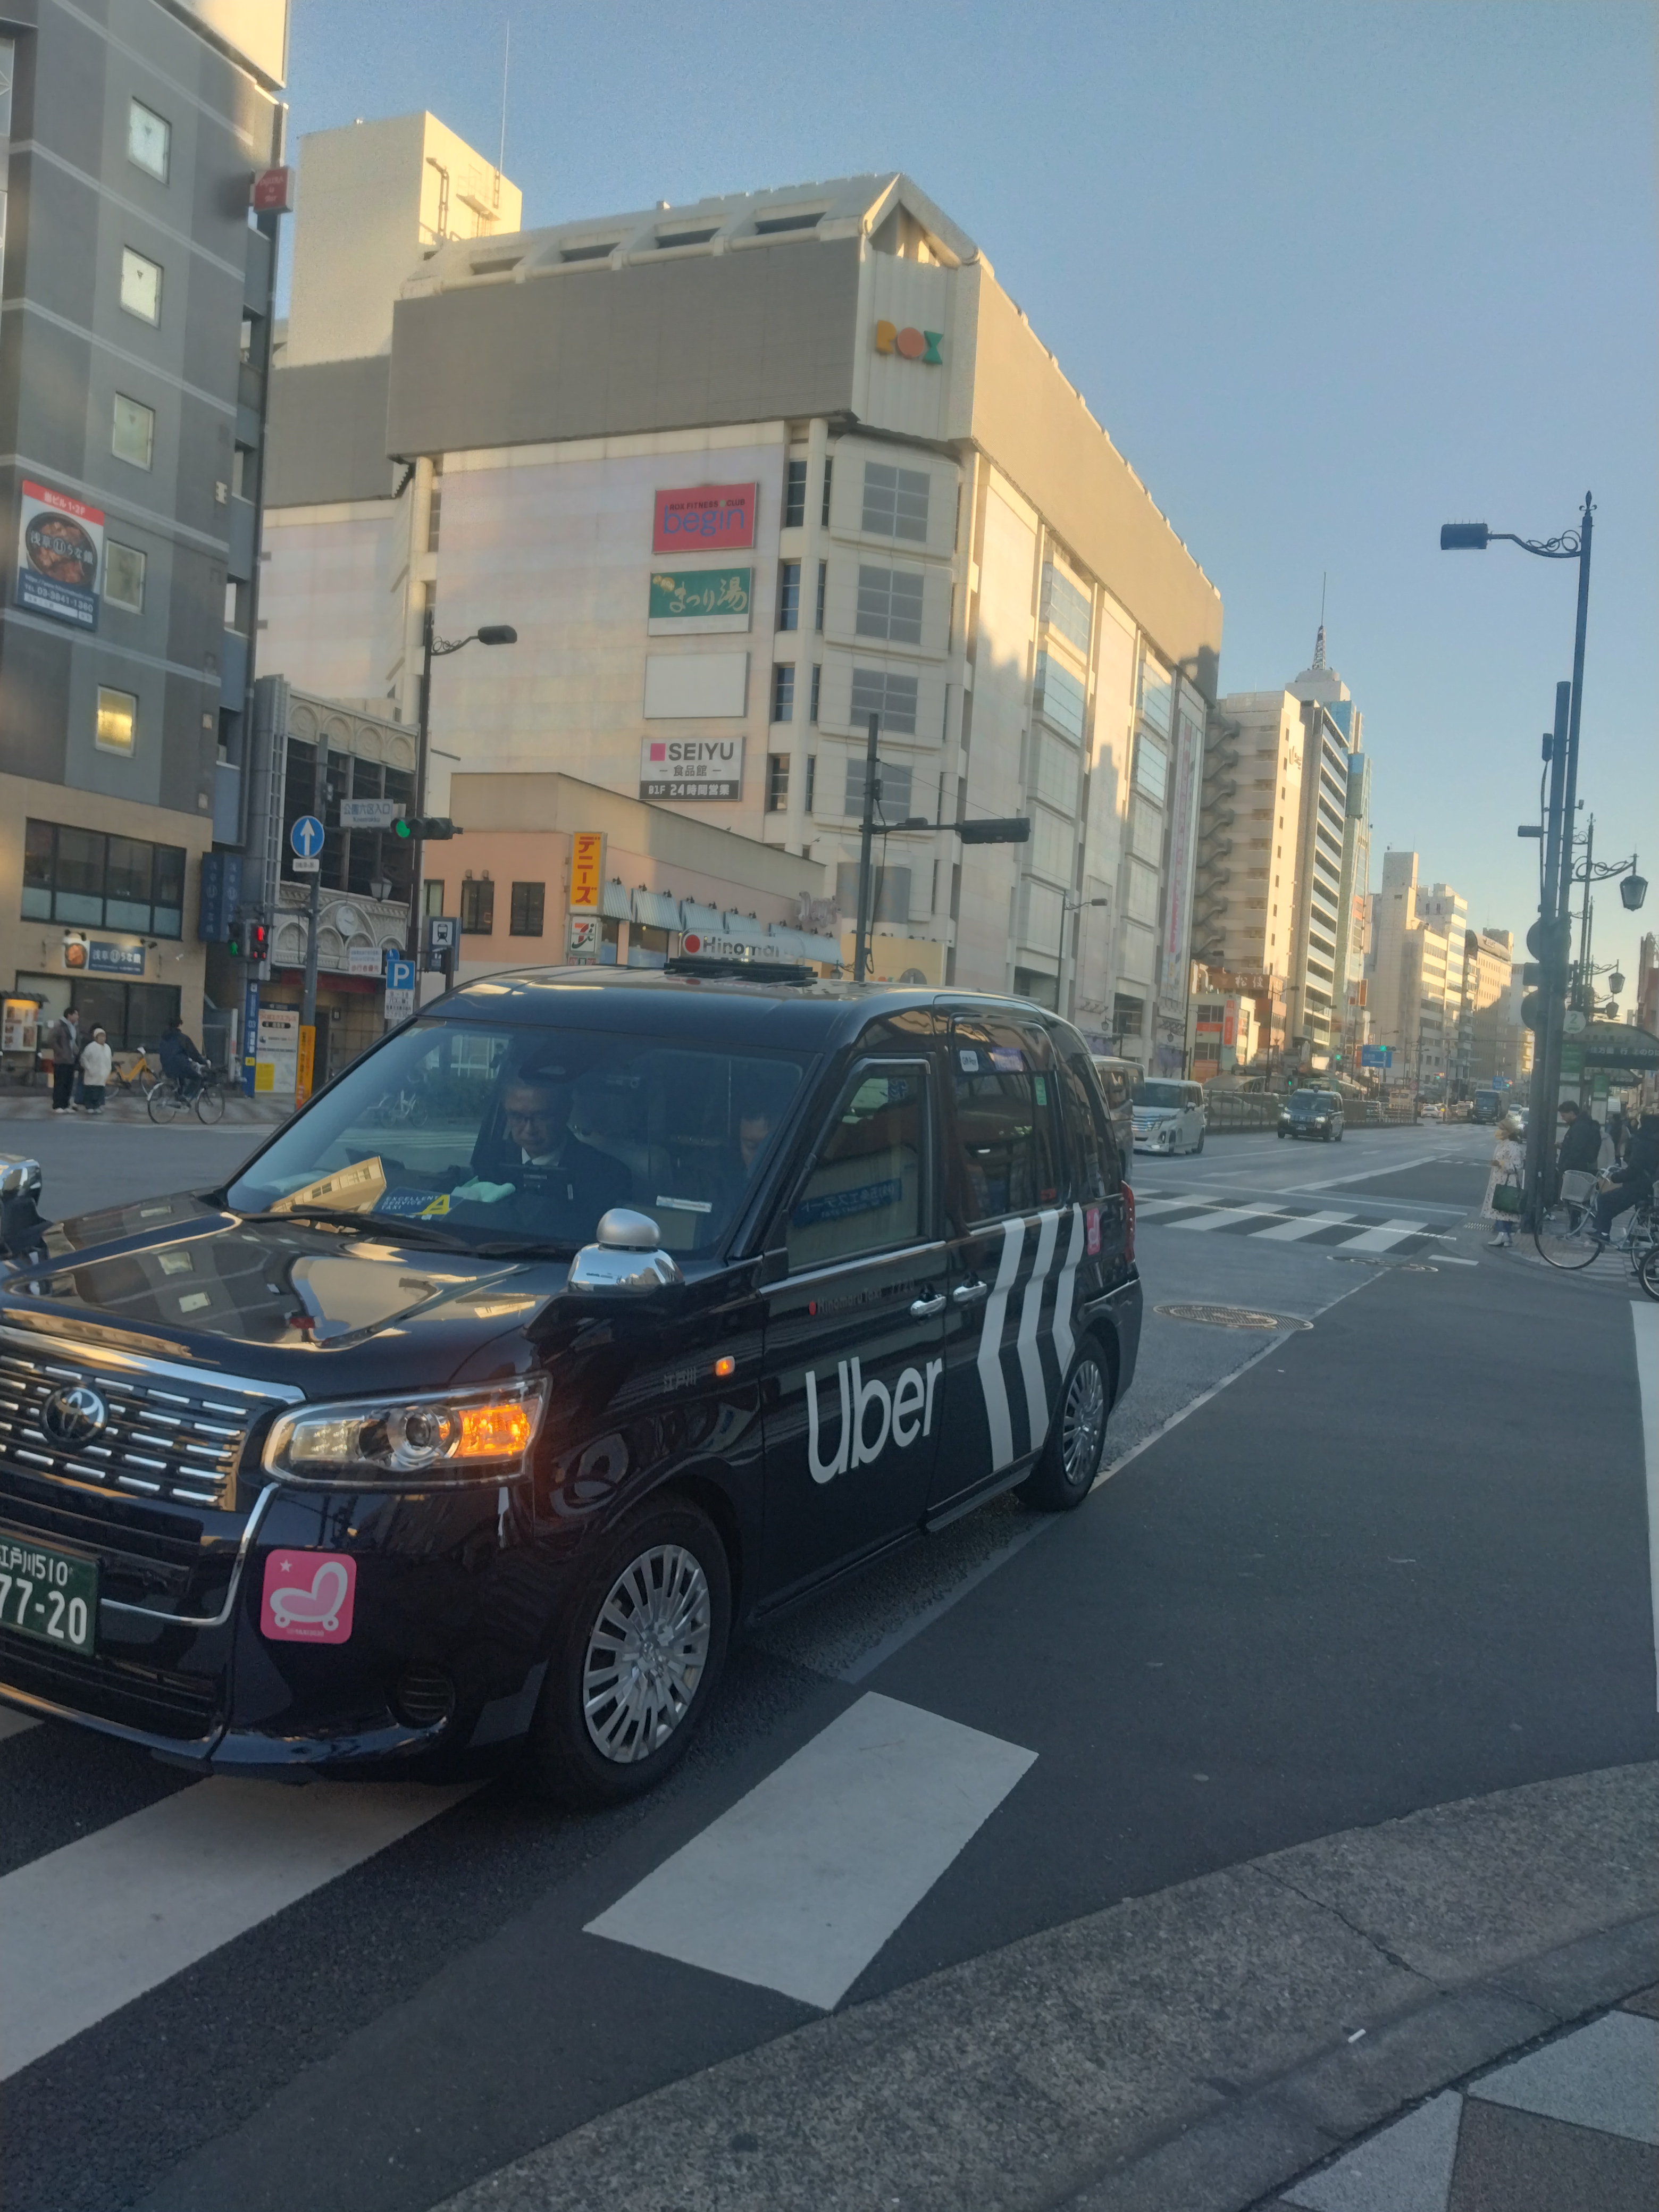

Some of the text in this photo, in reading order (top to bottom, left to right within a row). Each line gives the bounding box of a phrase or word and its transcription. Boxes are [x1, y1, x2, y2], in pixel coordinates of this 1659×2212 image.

[686, 500, 719, 509] FITNESS
[726, 498, 745, 507] CLUB
[663, 505, 744, 537] begin
[669, 576, 747, 613] まつり湯
[668, 742, 734, 761] SEIYU
[673, 765, 707, 777] 食品館
[648, 784, 730, 796] B1F 24時間営業
[575, 836, 601, 903] デニーズ
[1570, 1013, 1578, 1024] 2
[806, 1356, 942, 1484] Uber
